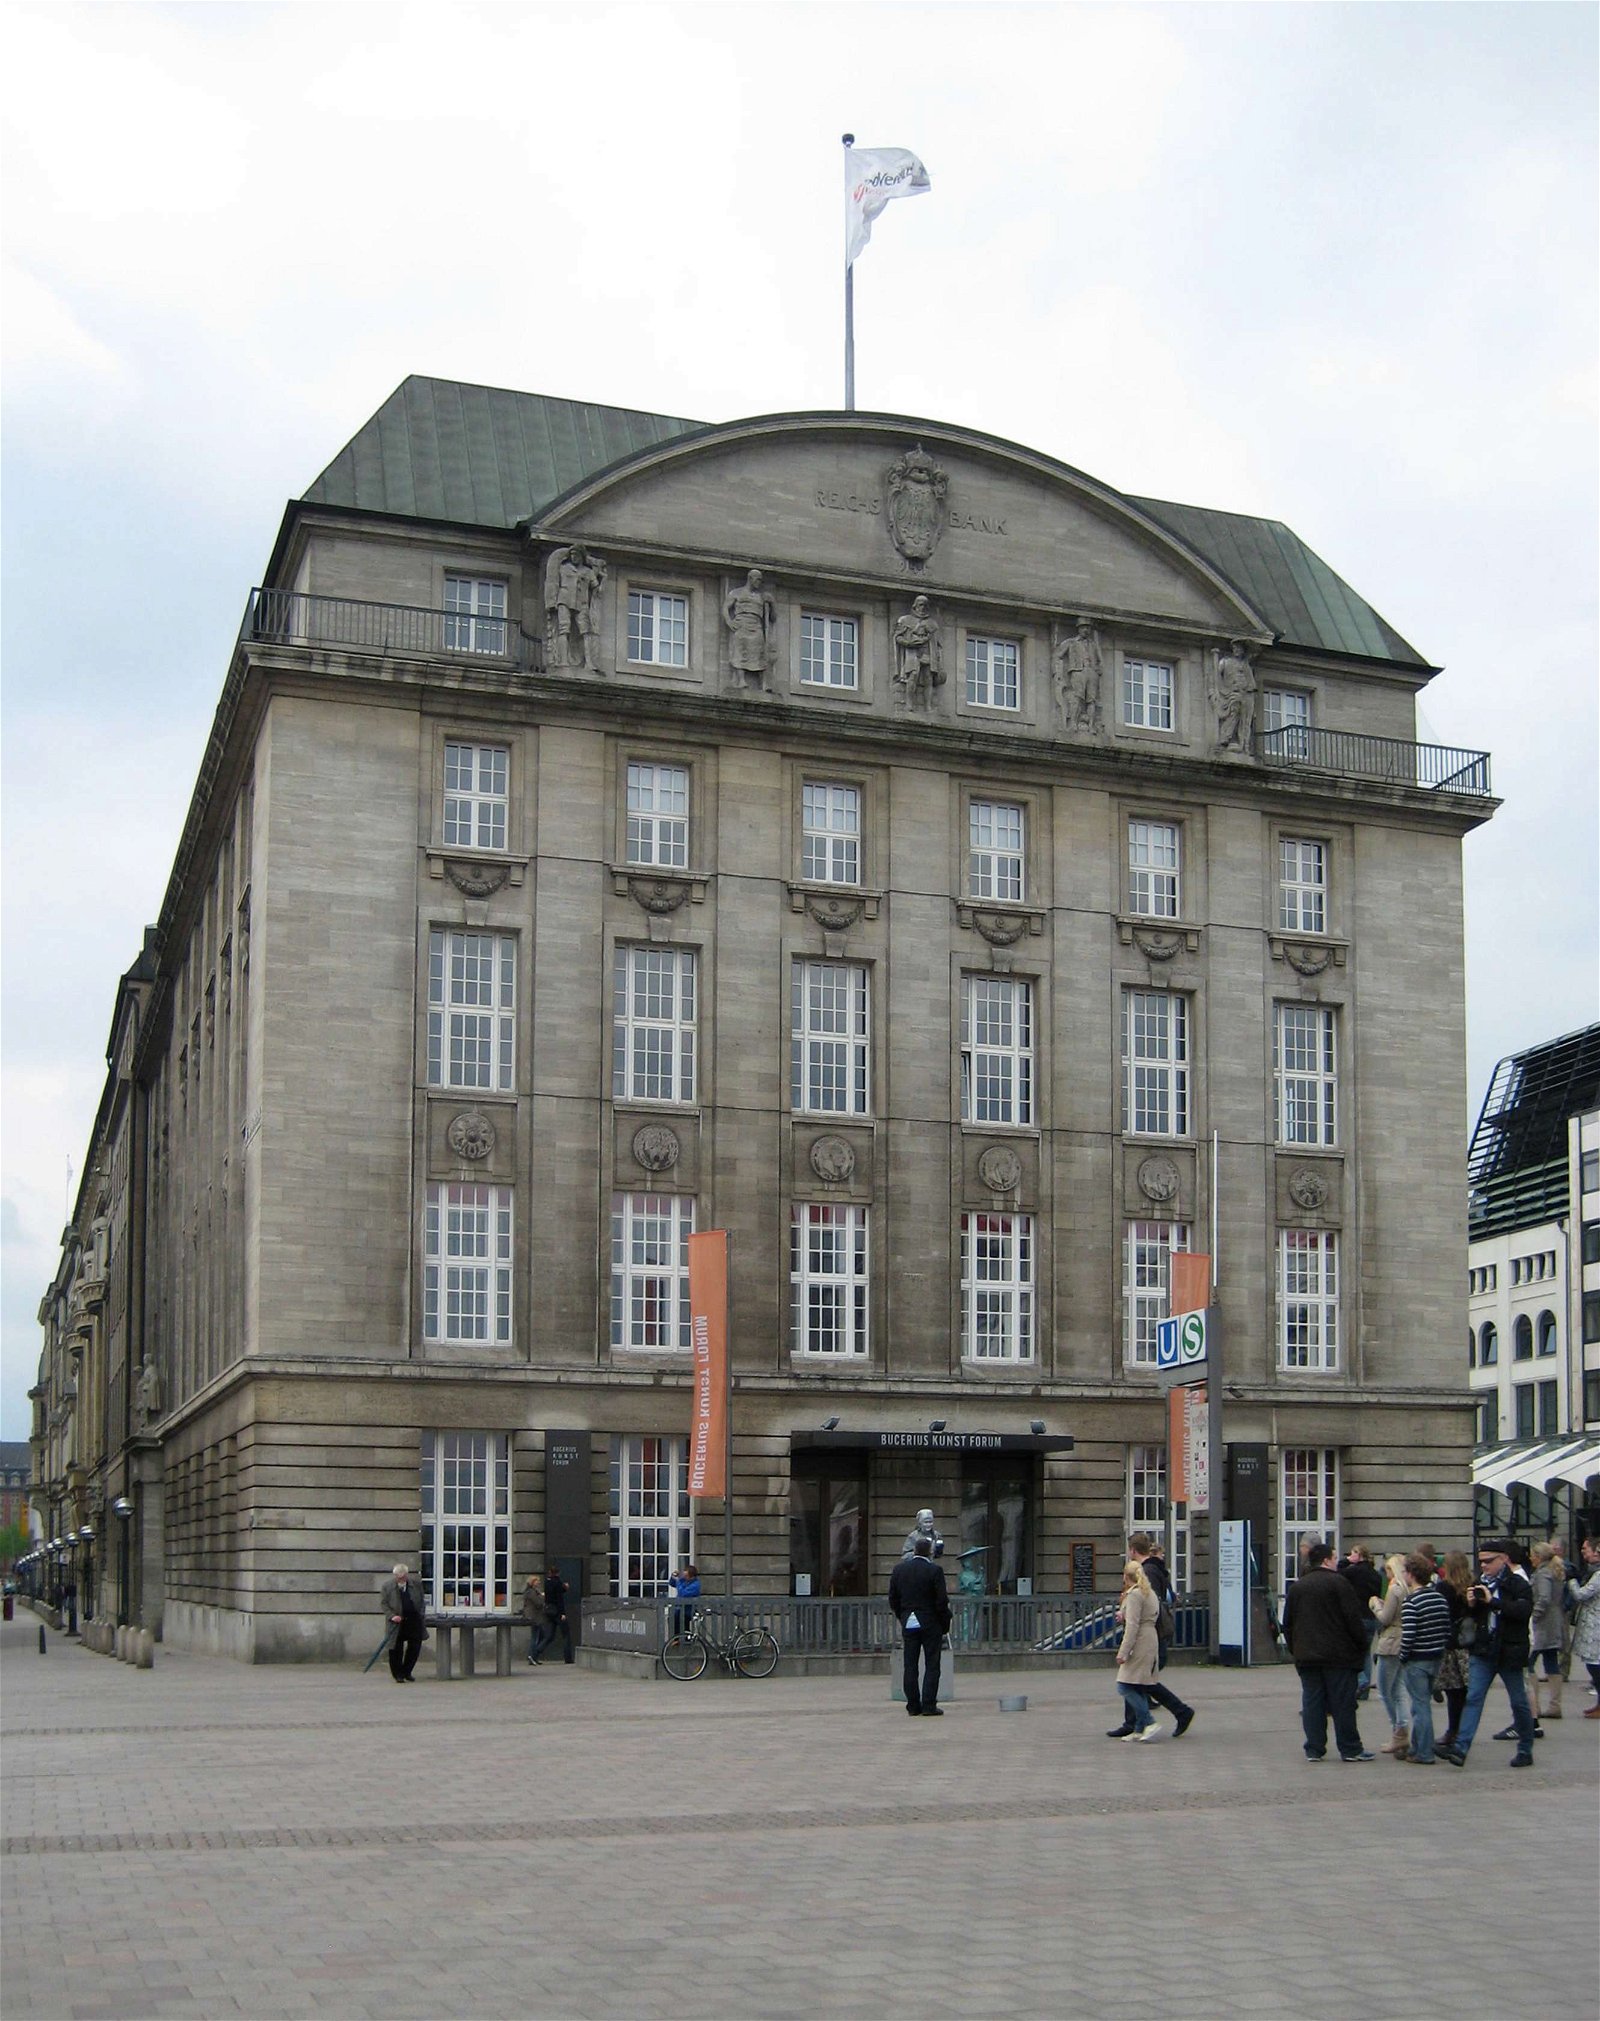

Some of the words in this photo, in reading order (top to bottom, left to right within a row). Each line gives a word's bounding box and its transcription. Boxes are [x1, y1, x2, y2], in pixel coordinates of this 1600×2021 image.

[948, 510, 1008, 536] BANK
[1160, 1323, 1176, 1361] U
[1185, 1317, 1201, 1356] S
[881, 1434, 929, 1446] BUCERIUS
[932, 1435, 966, 1447] KUNST
[969, 1436, 1002, 1447] FORUM
